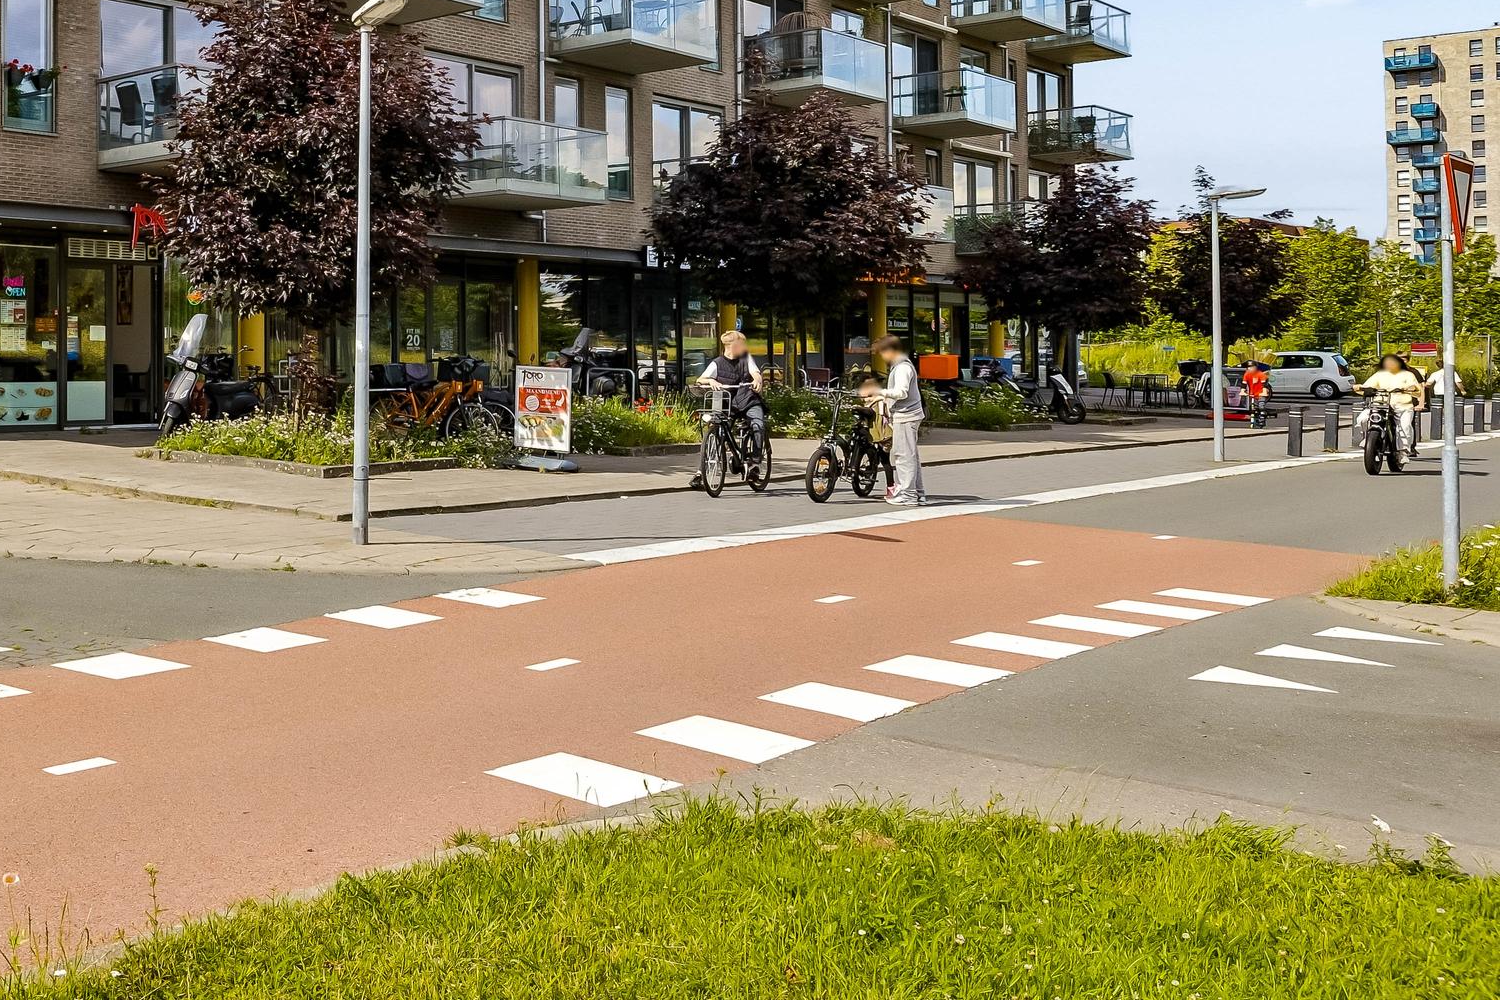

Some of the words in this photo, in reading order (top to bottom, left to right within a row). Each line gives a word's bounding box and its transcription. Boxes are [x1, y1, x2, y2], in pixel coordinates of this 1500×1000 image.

[5, 286, 26, 297] OPEN
[406, 334, 420, 346] 20
[521, 369, 544, 387] TORO
